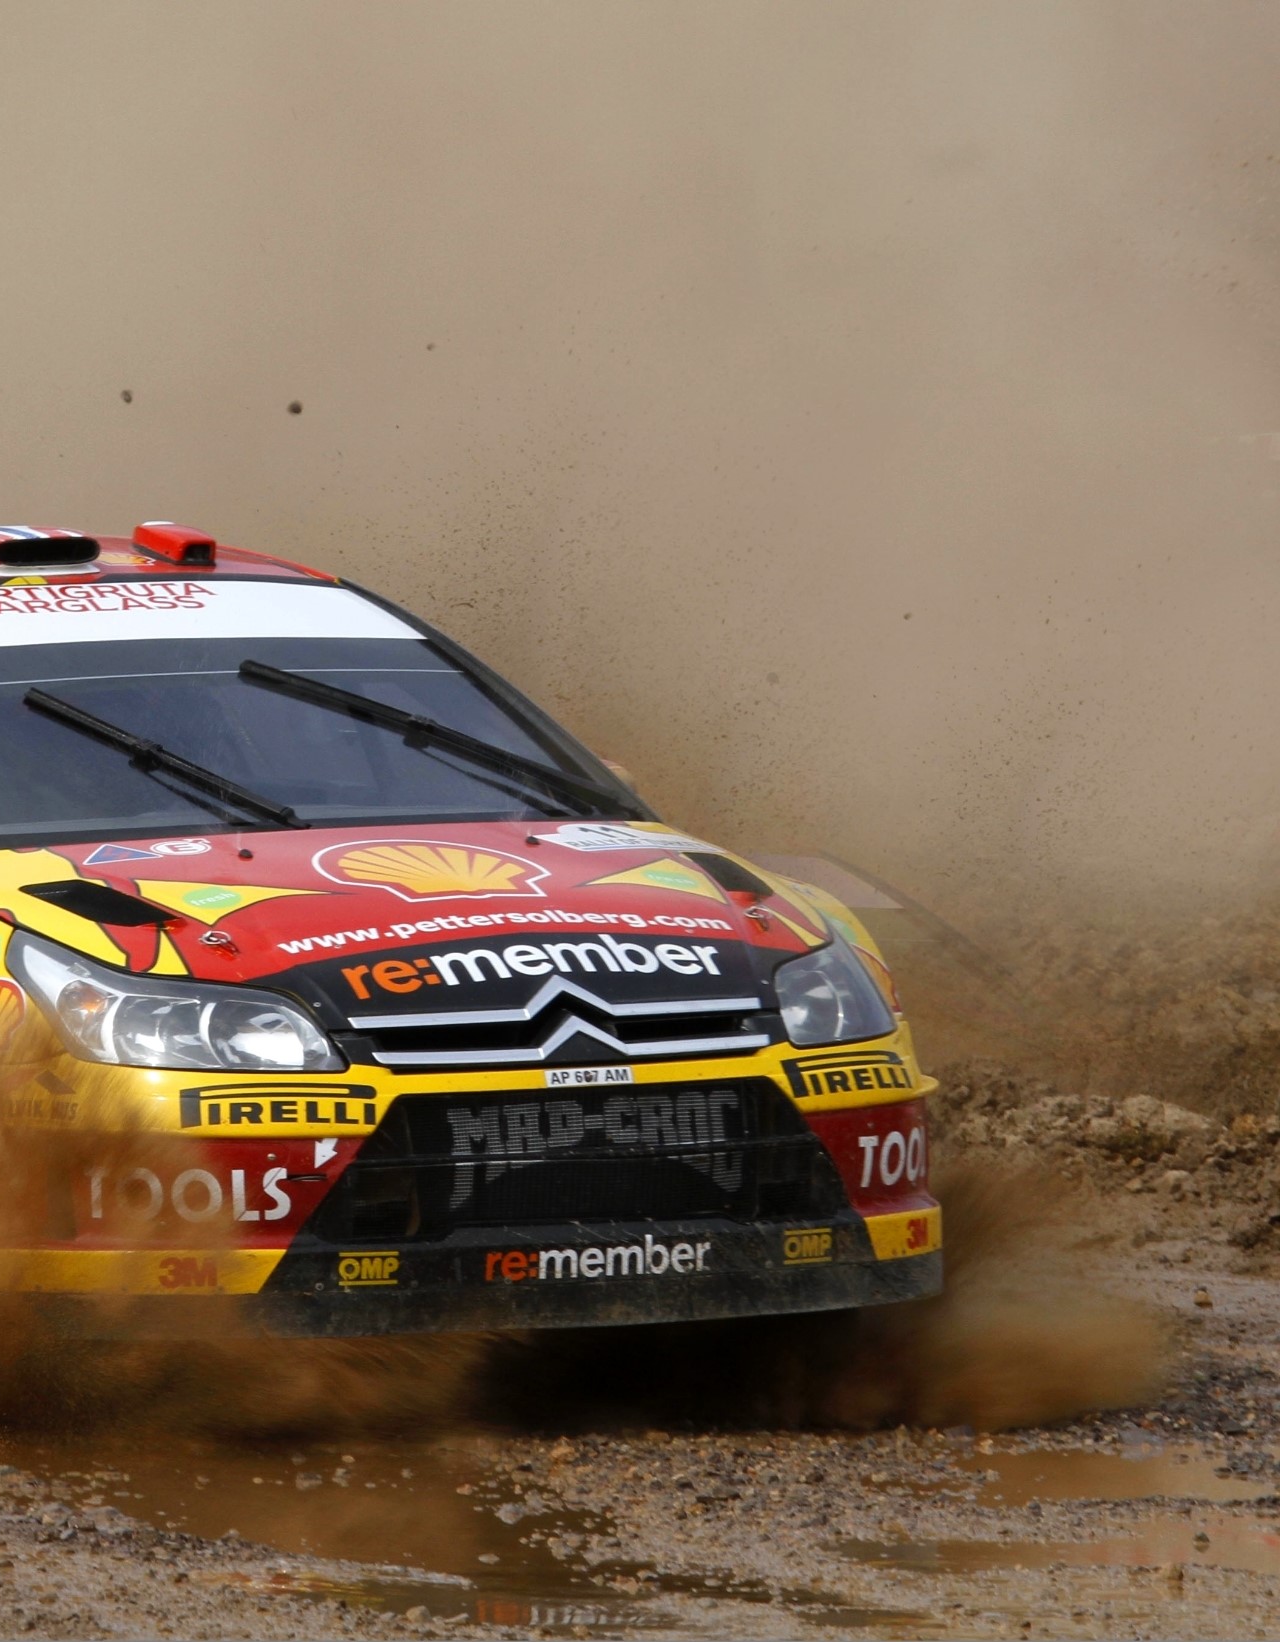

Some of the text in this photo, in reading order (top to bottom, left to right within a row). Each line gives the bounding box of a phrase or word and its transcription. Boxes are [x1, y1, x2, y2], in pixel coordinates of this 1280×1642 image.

[189, 892, 237, 907] fresh
[278, 909, 733, 955] www.pettersolberg.com
[341, 934, 722, 1001] re:member
[550, 1071, 570, 1085] AP
[604, 1068, 629, 1082] AM
[780, 1050, 912, 1098] PIRELLI
[180, 1082, 377, 1128] PIRELLI
[84, 1167, 292, 1222] TOOLS
[338, 1257, 400, 1280] OMP
[484, 1235, 712, 1281] re:member
[783, 1232, 832, 1260] OMP
[158, 1258, 218, 1288] 3M
